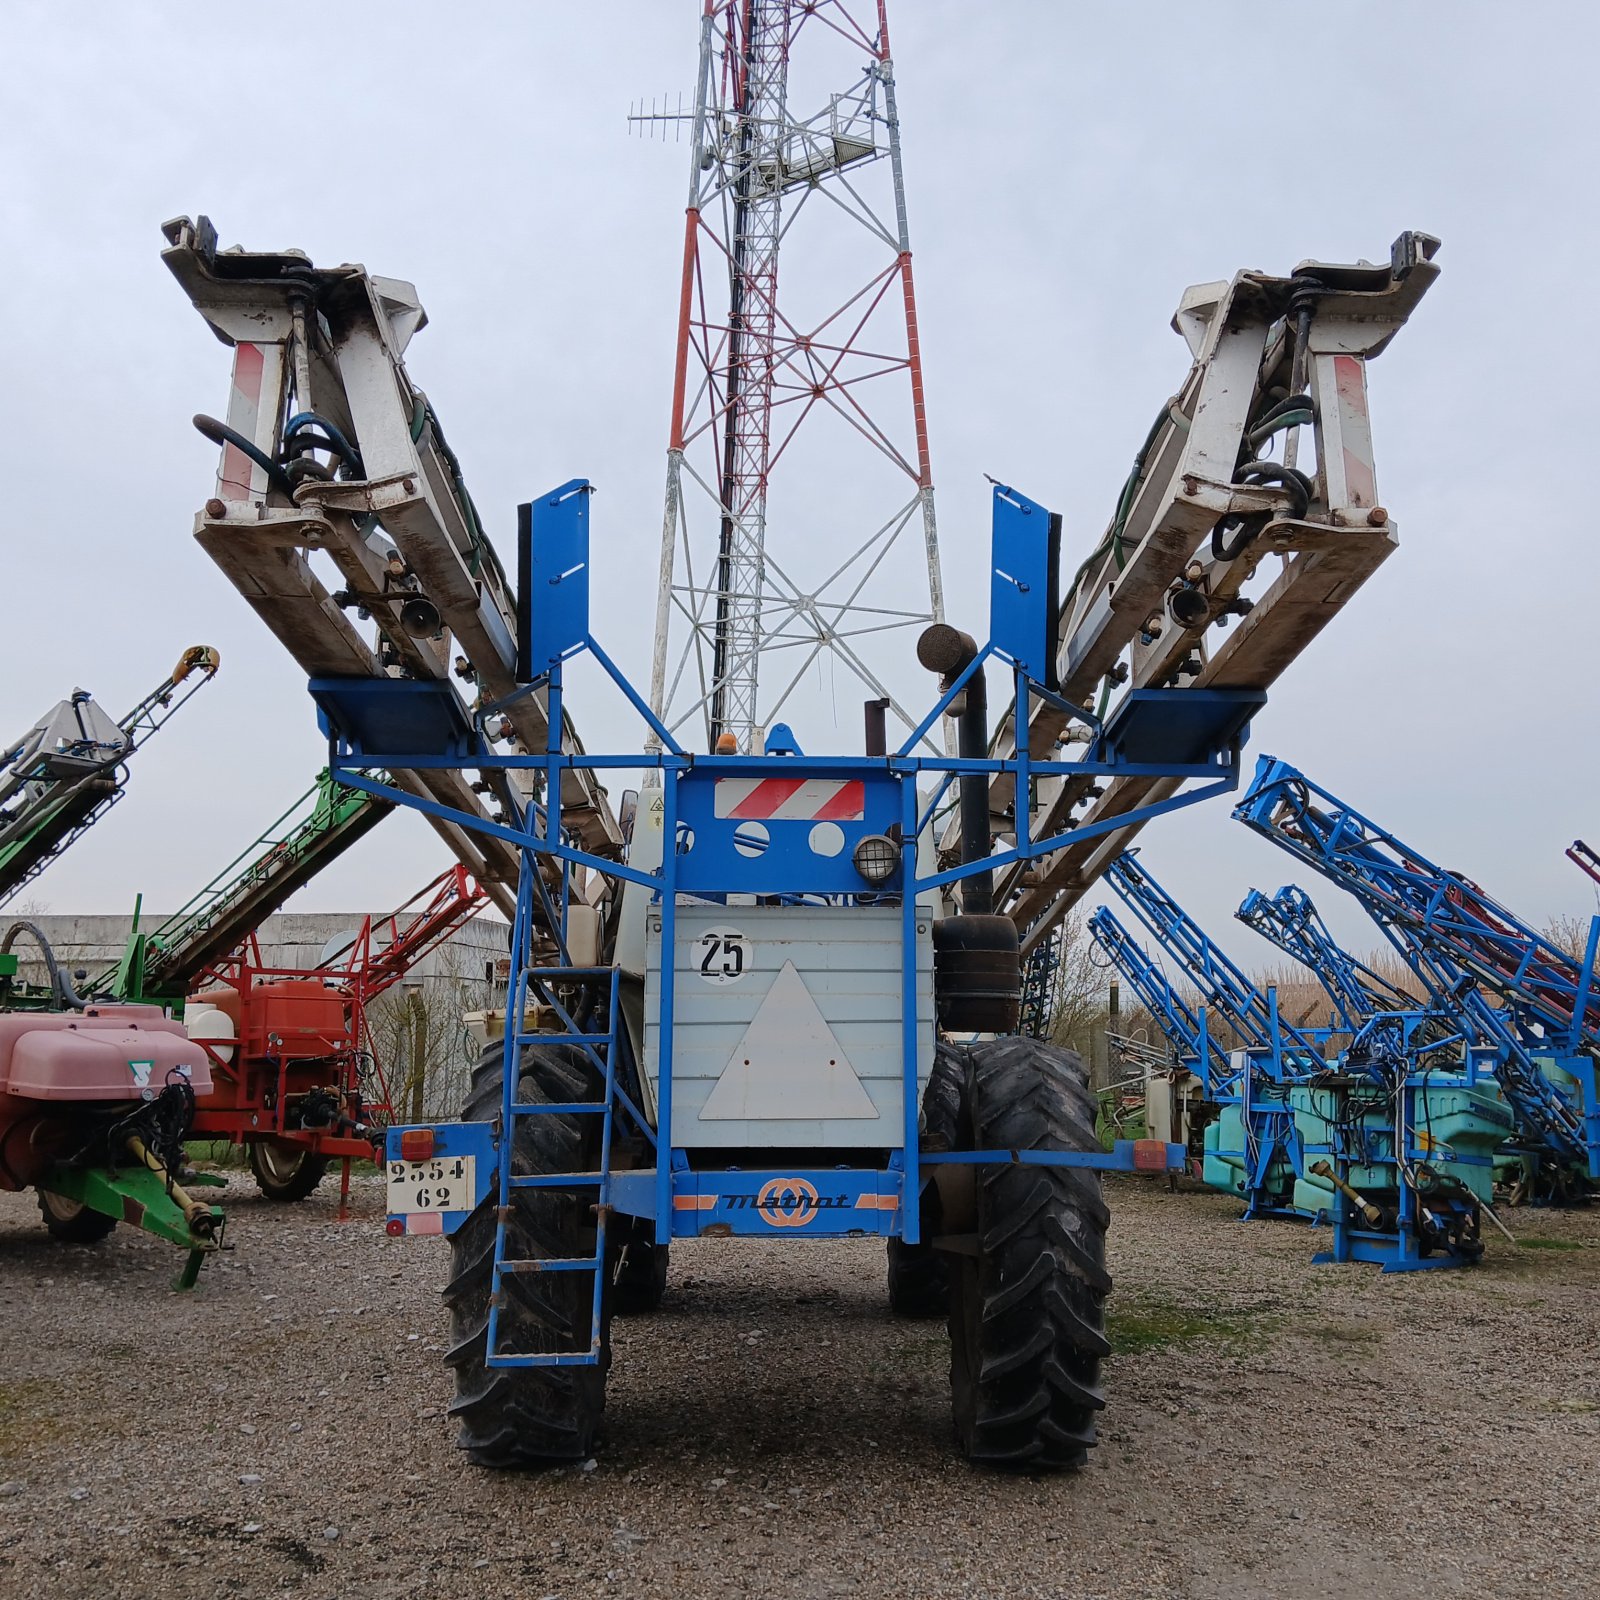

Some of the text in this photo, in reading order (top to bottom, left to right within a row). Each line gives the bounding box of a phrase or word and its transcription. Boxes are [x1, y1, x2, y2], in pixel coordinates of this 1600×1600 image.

[701, 933, 743, 978] 25
[391, 1160, 464, 1183] 2354
[416, 1187, 450, 1208] 62
